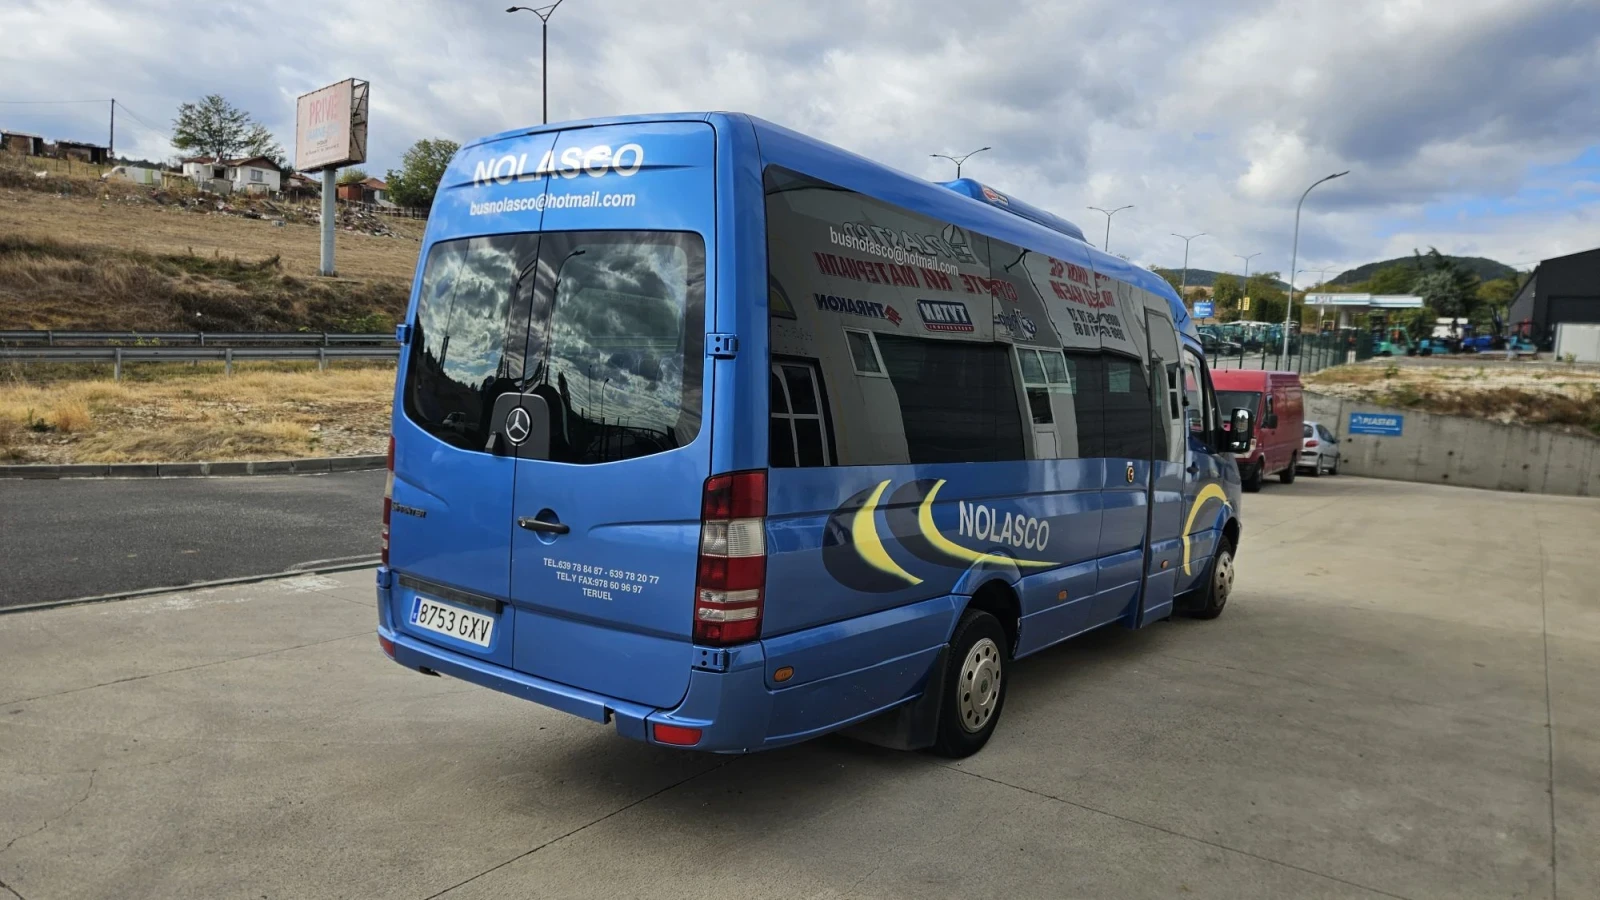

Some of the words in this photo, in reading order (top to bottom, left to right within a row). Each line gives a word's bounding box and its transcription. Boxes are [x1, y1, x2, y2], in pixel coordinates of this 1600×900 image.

[473, 143, 644, 189] NOLASCO
[469, 191, 636, 216] busnolasco@hotmail.com
[829, 226, 959, 277] busnolasco@hotmail.com
[959, 500, 1050, 551] NOLASCO
[543, 557, 571, 570] TEL.639
[572, 563, 582, 572] 78
[583, 565, 592, 574] 84
[593, 566, 603, 575] 87
[609, 569, 624, 579] 639
[625, 572, 635, 581] 78
[637, 573, 647, 583] 20
[649, 575, 660, 585] 77
[556, 571, 577, 582] TEL.Y
[578, 576, 608, 588] FAX:978
[609, 581, 619, 590] 60
[621, 583, 631, 592] 96
[632, 585, 643, 594] 97
[582, 587, 613, 601] TERUEL
[419, 603, 456, 631] 8753
[459, 615, 490, 641] GXV
